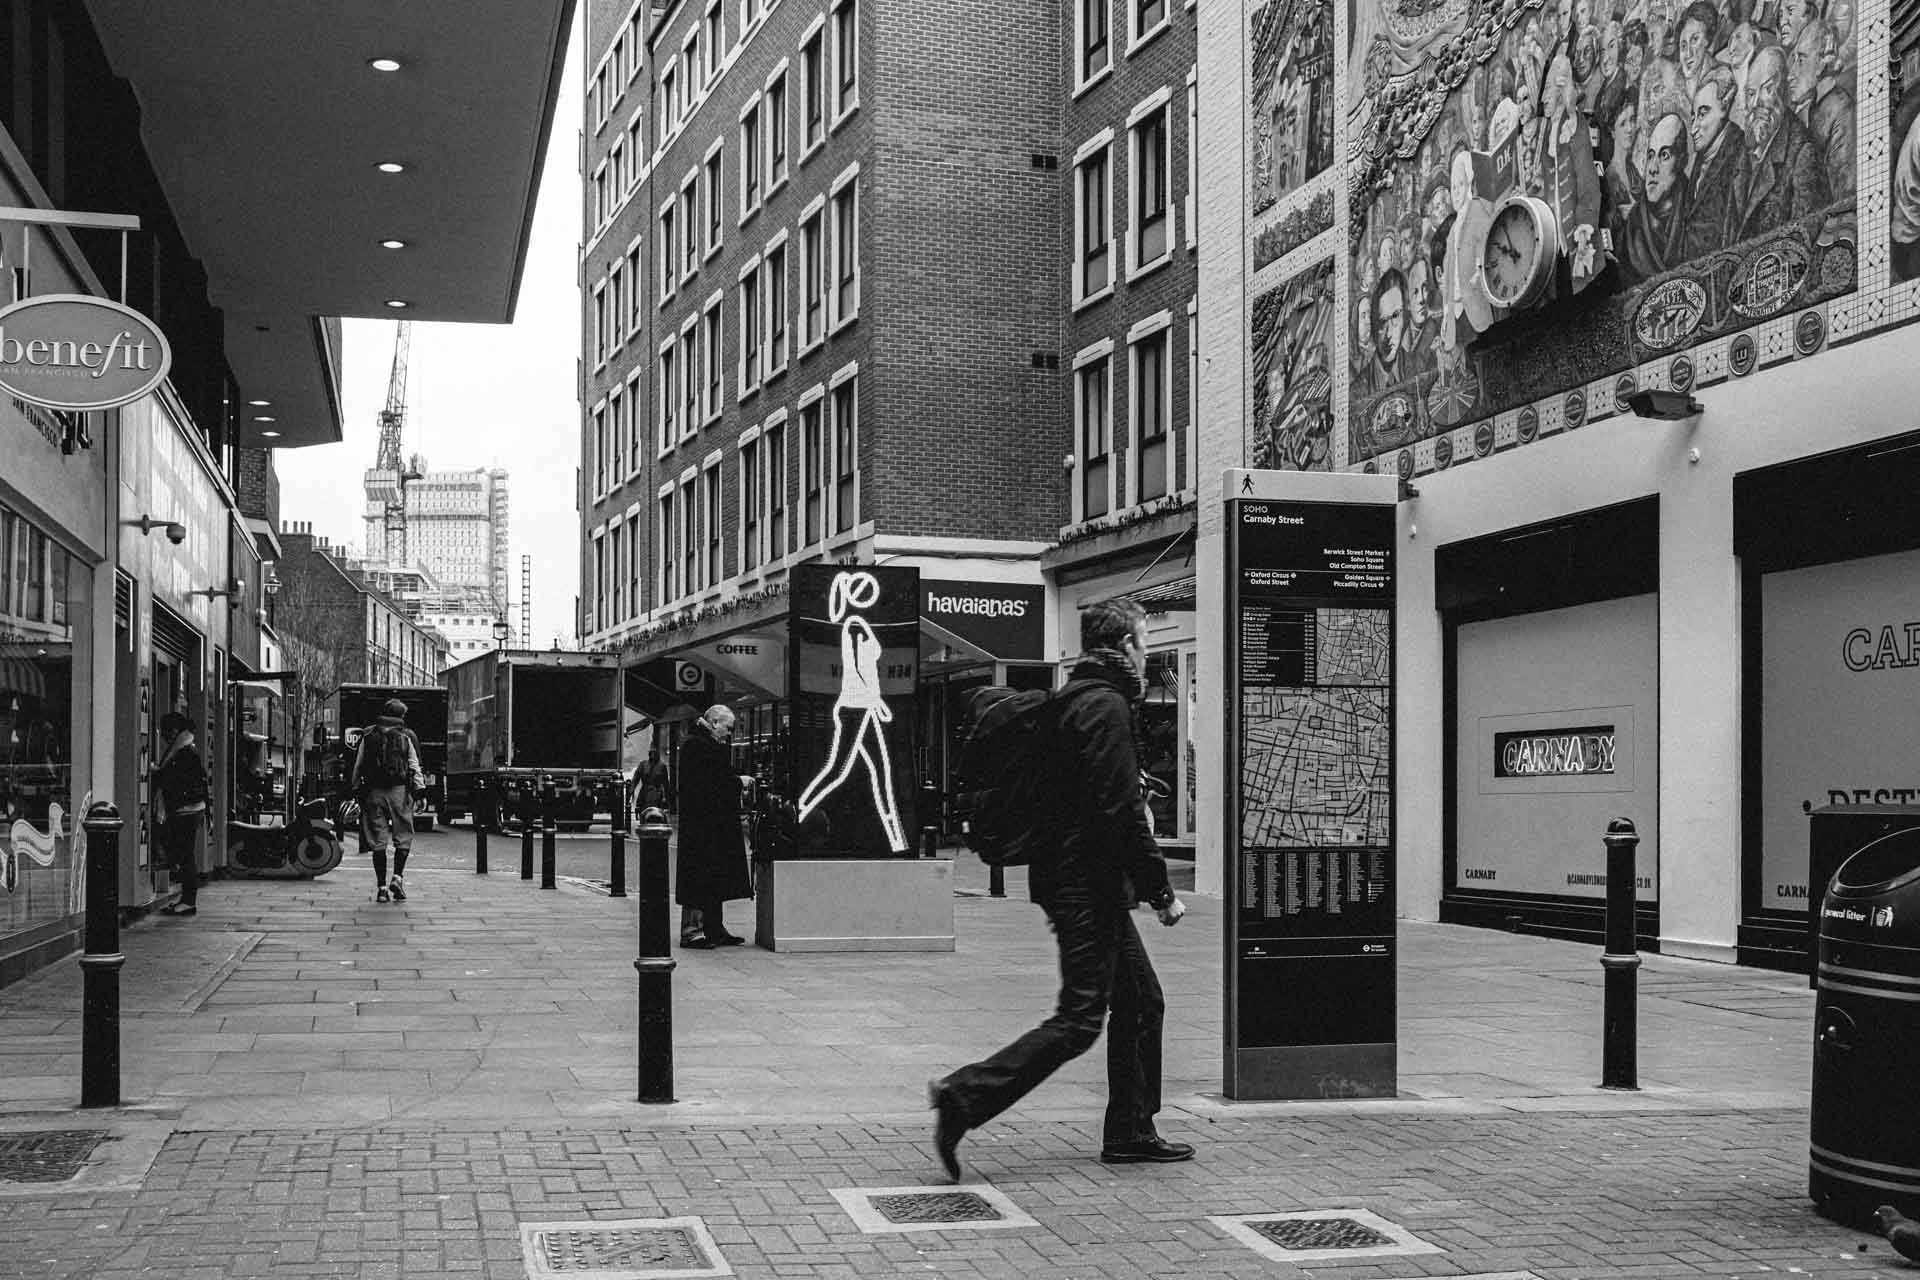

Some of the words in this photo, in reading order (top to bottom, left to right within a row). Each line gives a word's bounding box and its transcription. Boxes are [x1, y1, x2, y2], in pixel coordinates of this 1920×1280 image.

[0, 326, 153, 379] benefit
[1243, 505, 1268, 513] SOHO
[1243, 514, 1277, 525] Carnaby
[1278, 515, 1304, 525] Street
[1340, 562, 1366, 570] Compton
[1333, 580, 1359, 588] Piccadilly
[928, 591, 1025, 617] havaianas
[715, 643, 759, 656] COFFEE
[1842, 621, 1920, 672] CAR
[1503, 735, 1616, 773] CARNABY
[1465, 868, 1497, 880] CARNABY
[1846, 909, 1866, 921] litter
